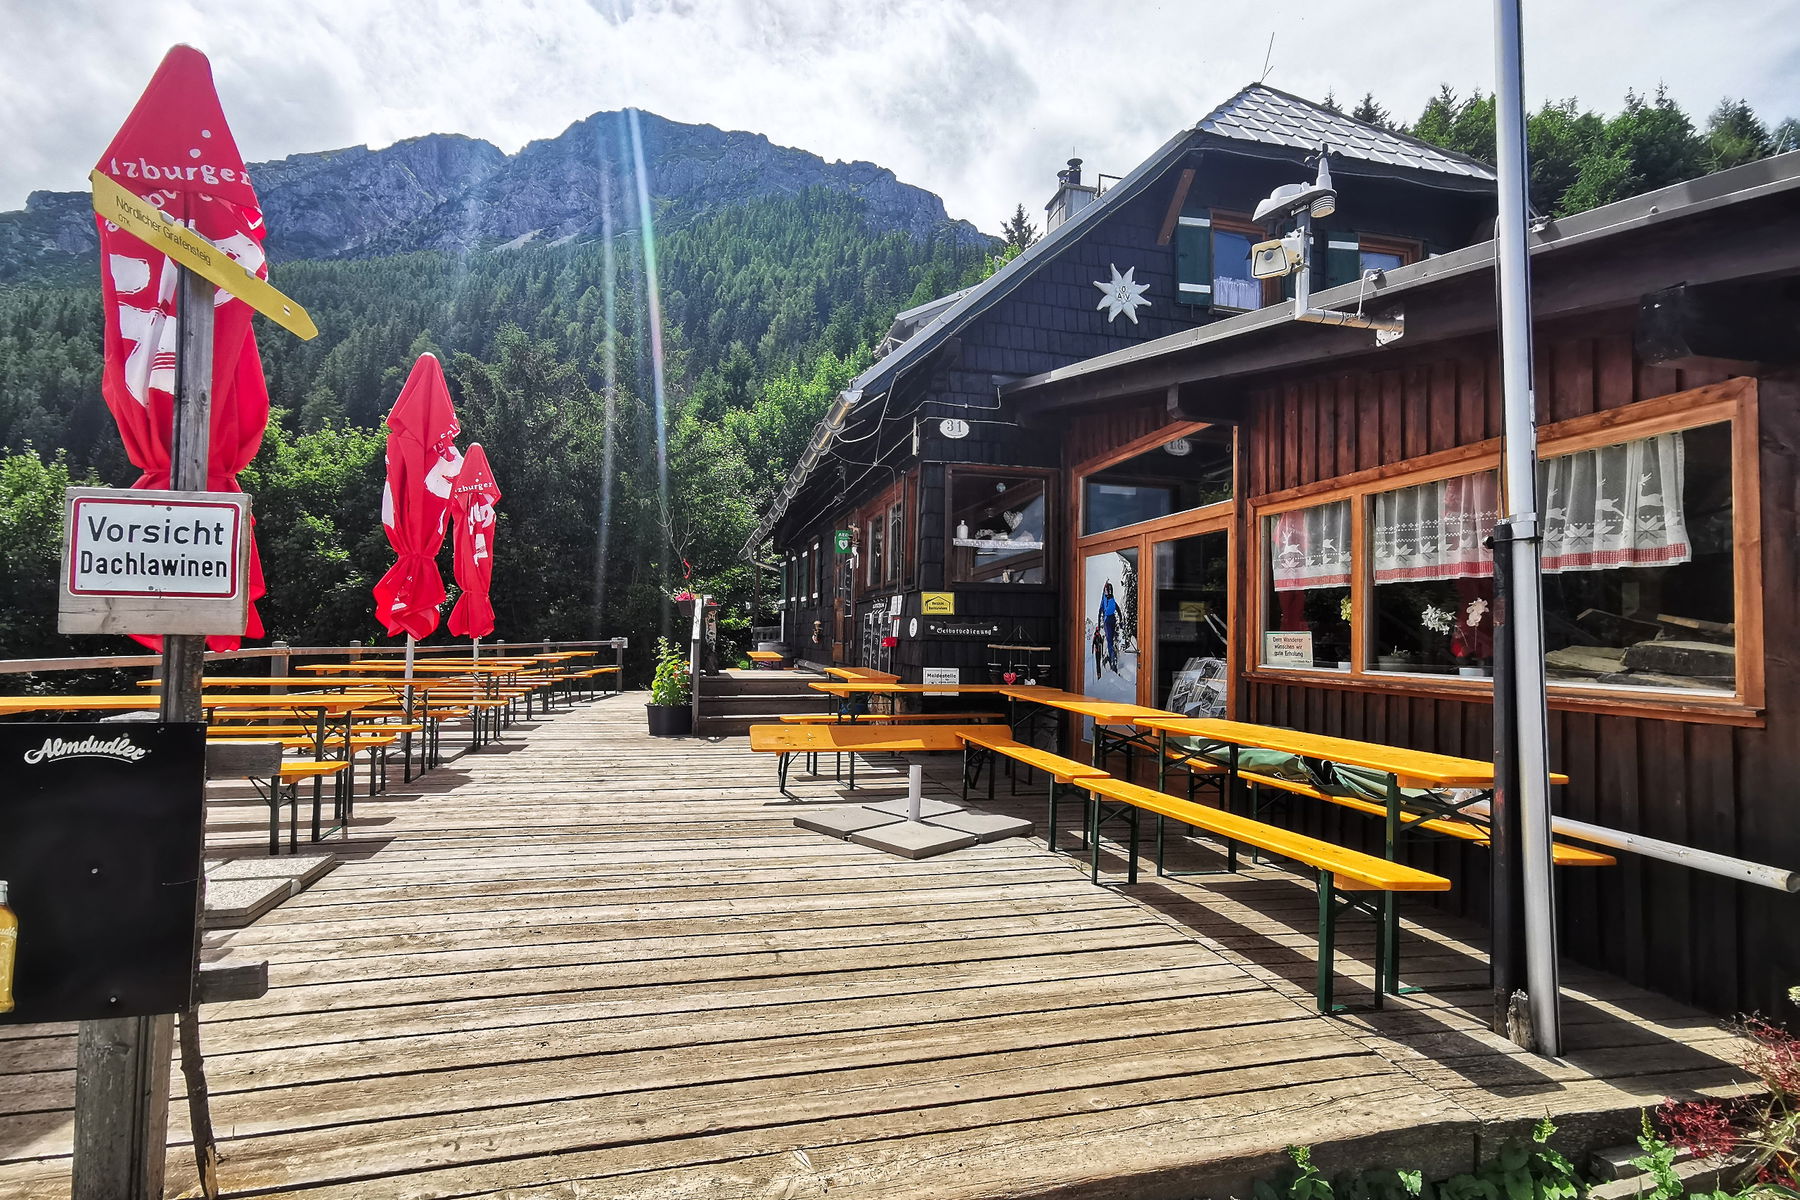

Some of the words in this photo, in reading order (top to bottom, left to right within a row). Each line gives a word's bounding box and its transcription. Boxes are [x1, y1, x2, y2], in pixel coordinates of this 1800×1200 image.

[162, 225, 211, 266] Grafensteig
[946, 419, 962, 433] 31
[87, 515, 224, 546] Vorsicht
[80, 550, 227, 578] Dachlawinen
[23, 735, 146, 765] Almdudler
